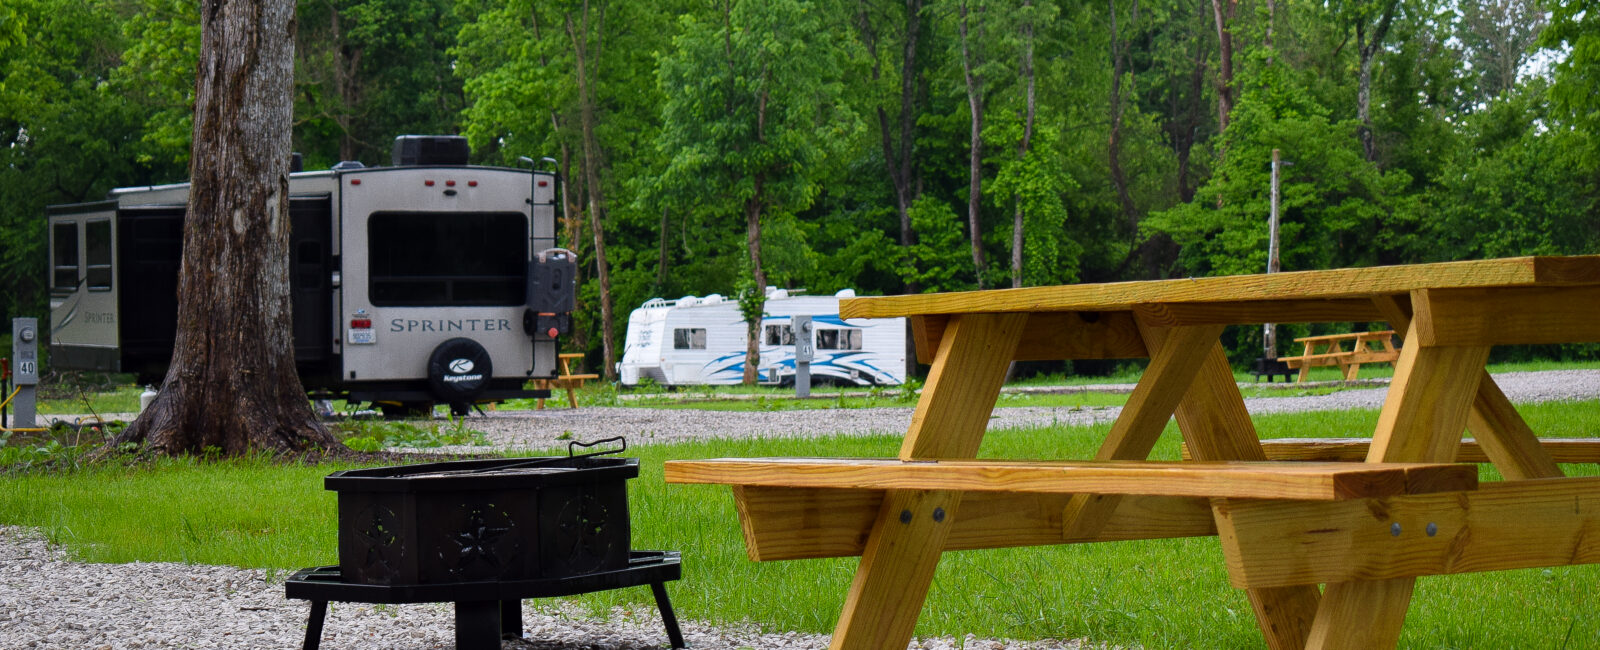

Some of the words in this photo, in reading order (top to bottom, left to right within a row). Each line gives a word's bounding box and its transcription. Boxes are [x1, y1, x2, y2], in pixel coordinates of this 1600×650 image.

[84, 311, 114, 323] SPRINTER
[390, 318, 511, 332] SPRINTER
[21, 362, 34, 374] 40
[443, 374, 482, 383] Keystone
